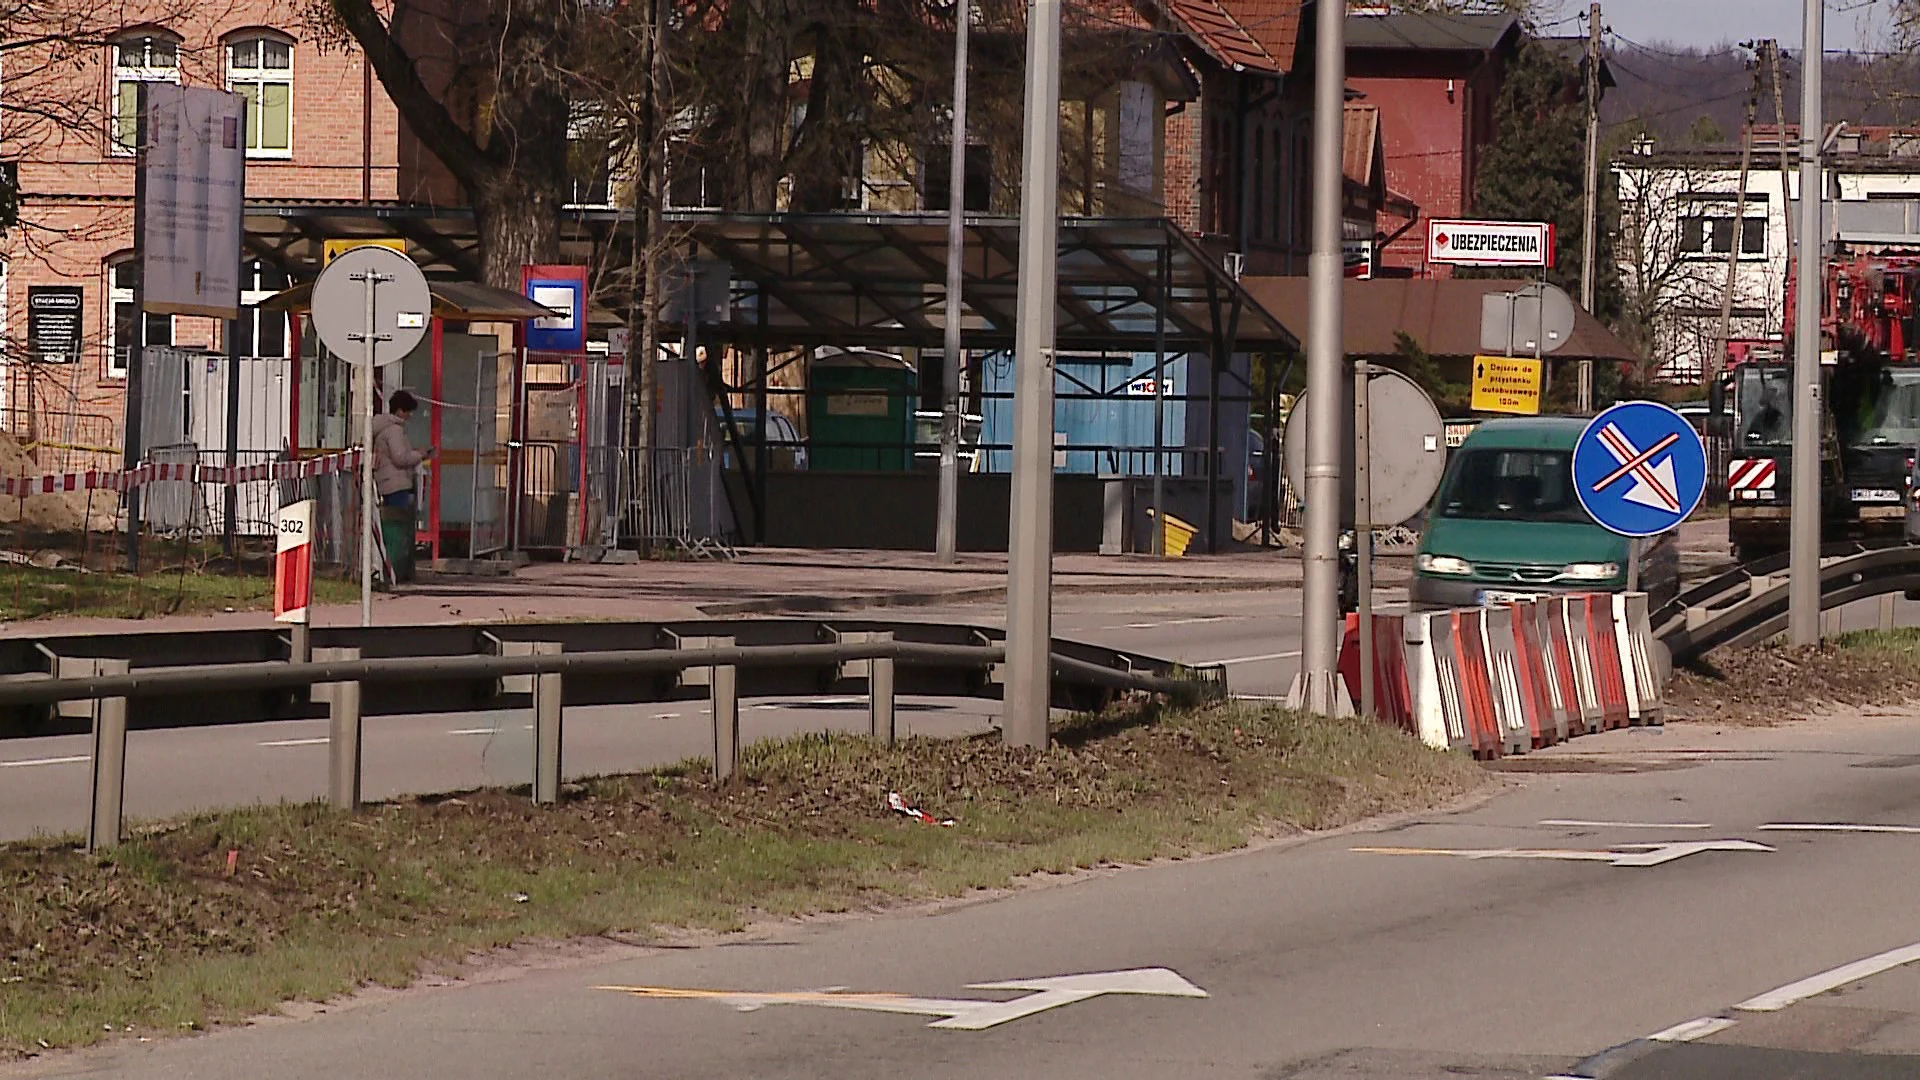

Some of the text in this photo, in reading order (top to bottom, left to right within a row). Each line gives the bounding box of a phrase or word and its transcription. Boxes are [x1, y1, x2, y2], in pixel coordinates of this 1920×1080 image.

[1451, 233, 1538, 253] UBEZPIECZENIA
[1482, 387, 1537, 397] autobusowego
[281, 519, 303, 533] 302
